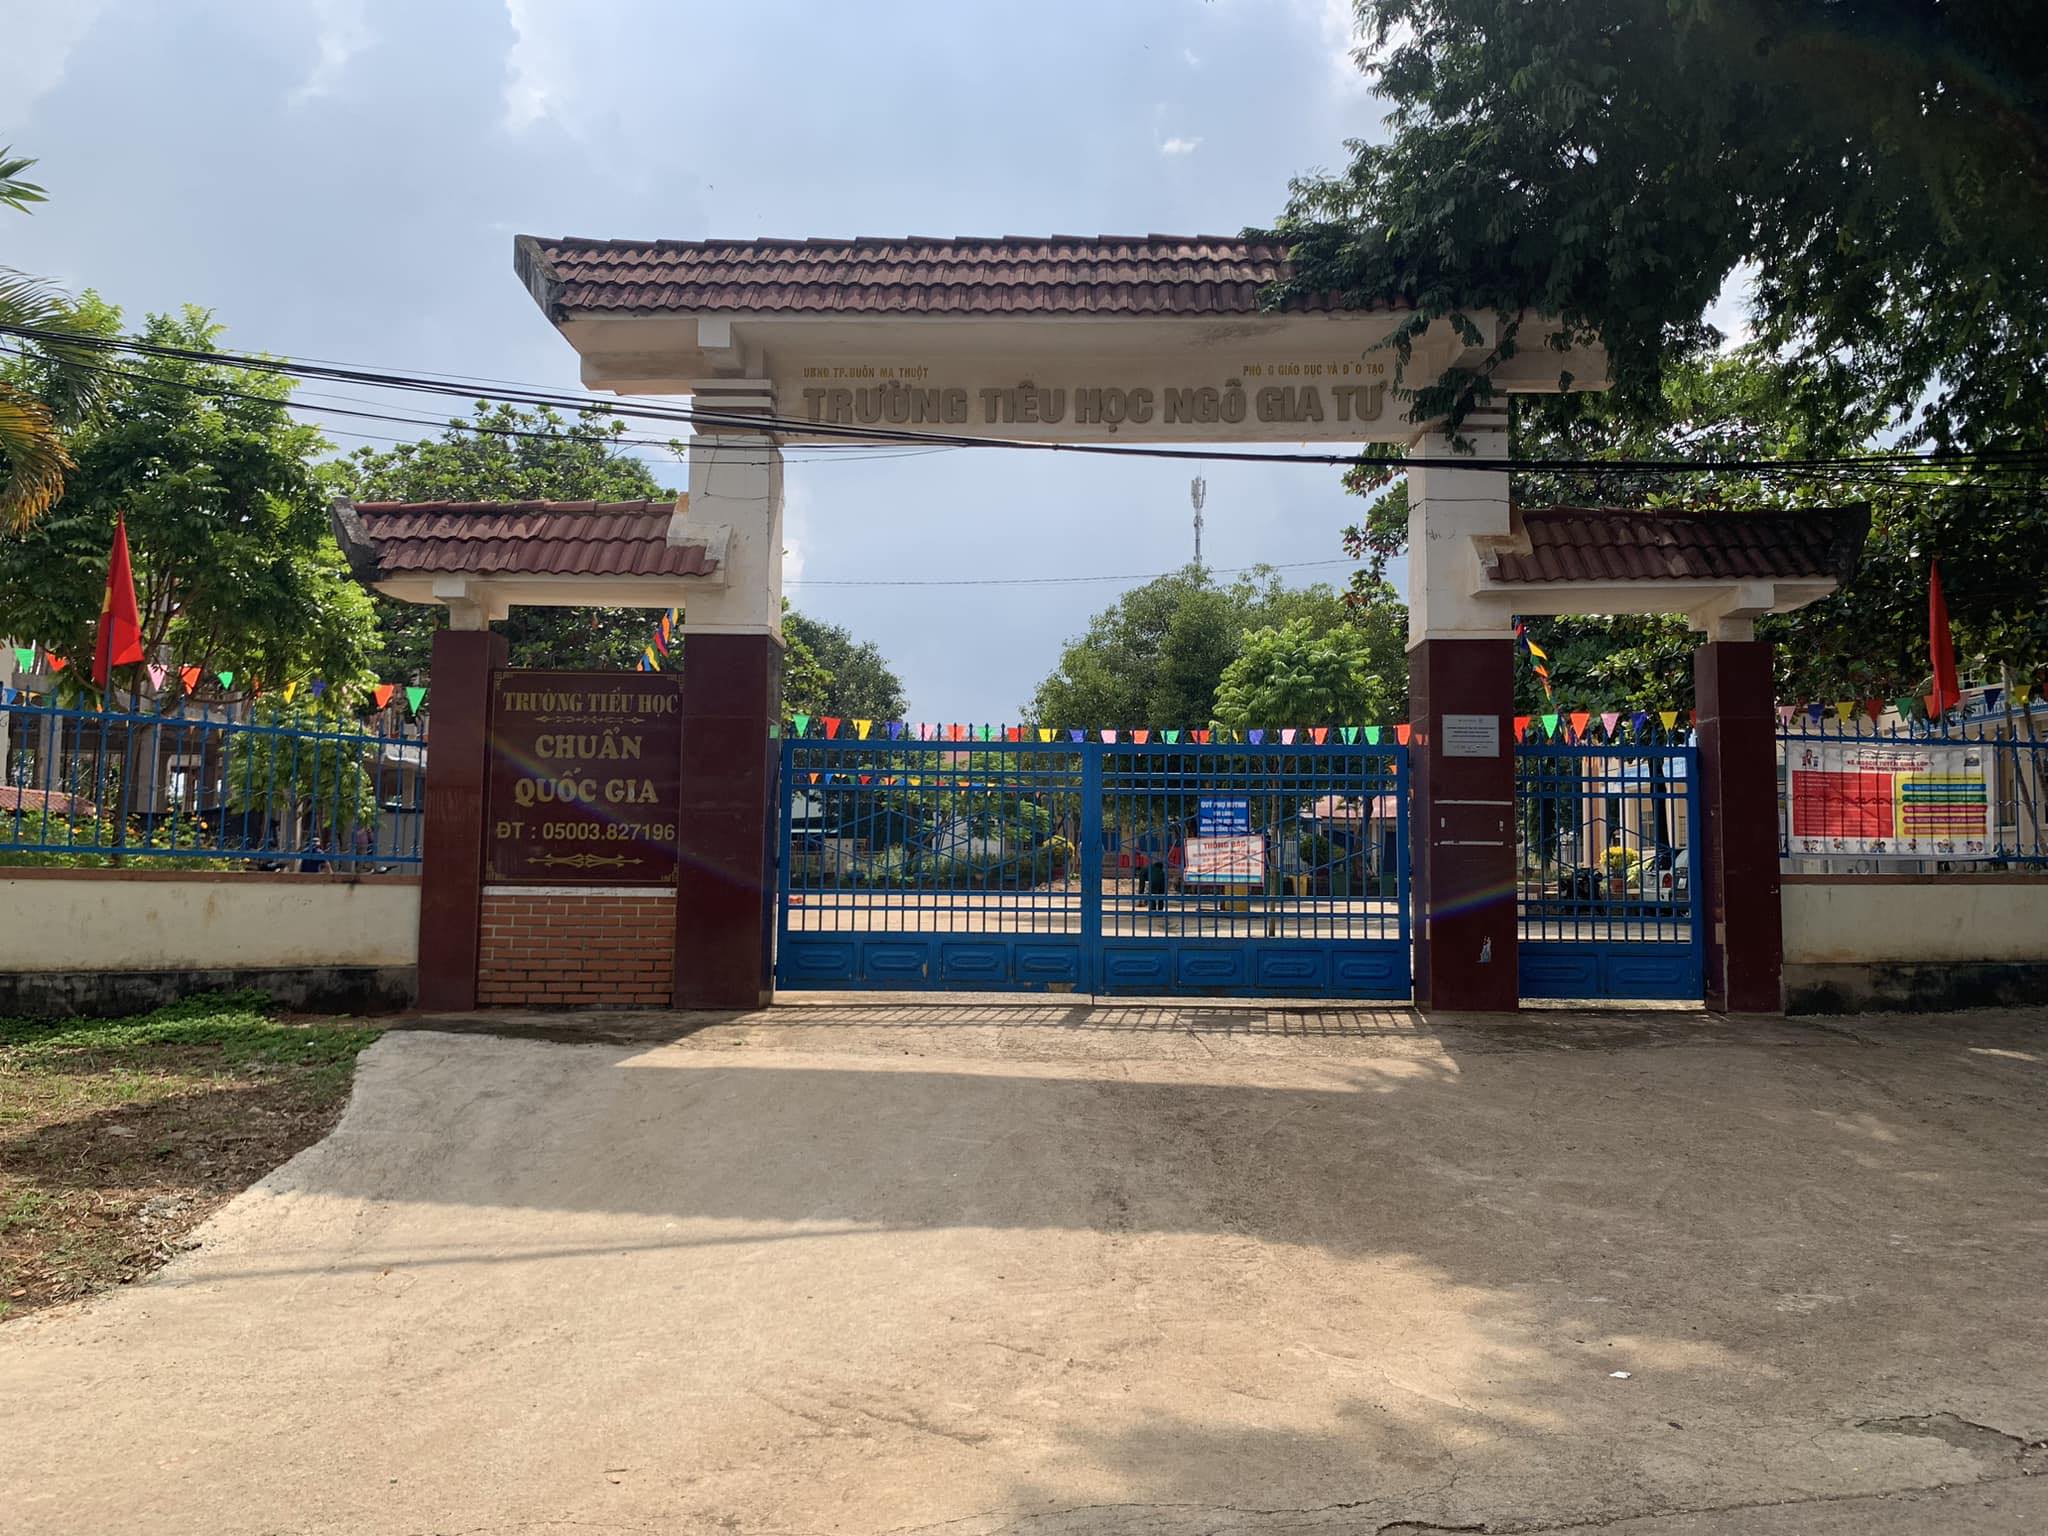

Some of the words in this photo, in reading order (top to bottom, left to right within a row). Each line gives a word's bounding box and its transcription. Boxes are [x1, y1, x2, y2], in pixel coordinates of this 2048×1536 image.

[879, 367, 895, 378] MA
[898, 364, 929, 380] THUỘT
[1278, 361, 1300, 377] GIÁO
[1303, 364, 1323, 378] DỤC
[1327, 361, 1338, 376] VÀ
[1367, 363, 1385, 377] TẠO
[802, 381, 968, 424] TRƯỜNG
[1074, 387, 1155, 433] HỌC
[1163, 378, 1247, 424] NGÔ
[1255, 385, 1325, 423] GIA
[1331, 380, 1389, 423] TƯ
[587, 686, 635, 714] TIỂU
[638, 692, 679, 718] HỌC
[534, 727, 643, 760] CHUẨN
[514, 767, 598, 808] QUỐC
[604, 779, 660, 804] GIA
[495, 821, 526, 839] ĐT
[542, 822, 677, 841] 05003.827196
